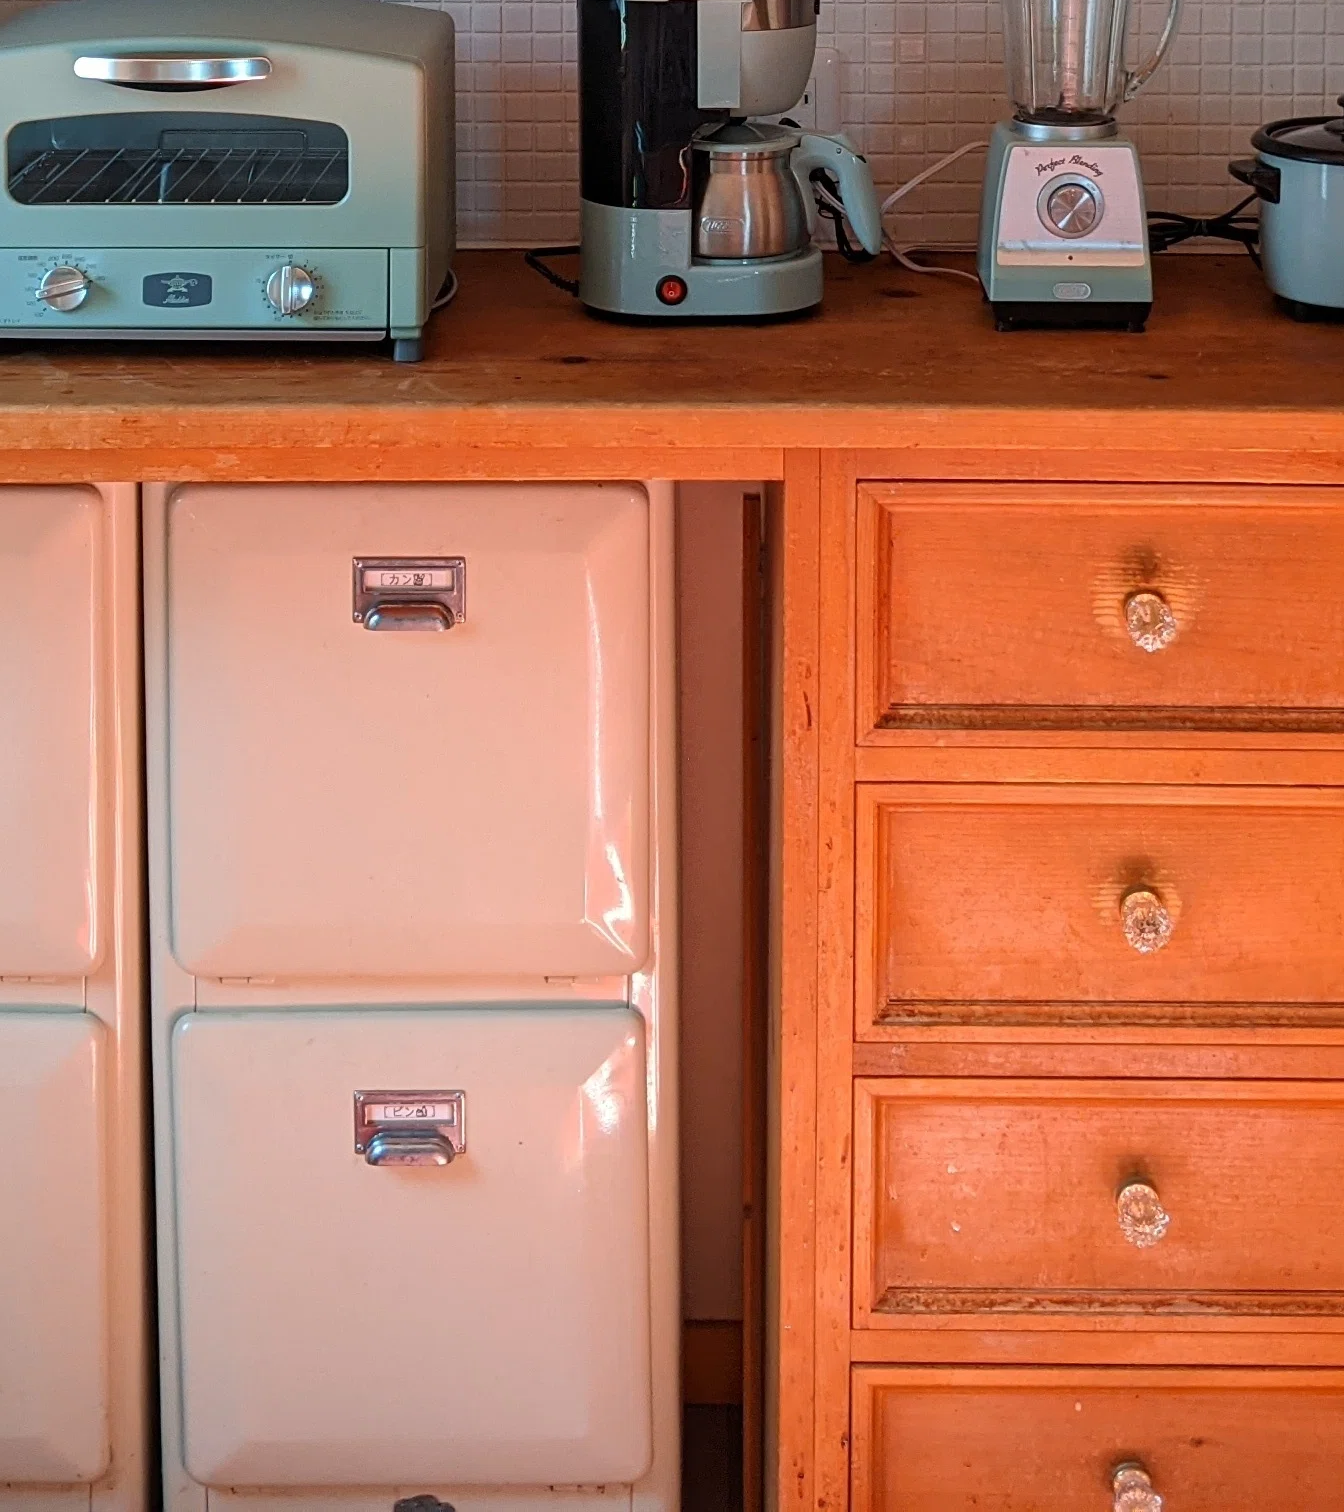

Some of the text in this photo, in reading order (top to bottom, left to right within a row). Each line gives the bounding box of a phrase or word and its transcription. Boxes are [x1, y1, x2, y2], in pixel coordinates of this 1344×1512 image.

[1035, 154, 1104, 178] Perfect Blending
[389, 574, 412, 586] カン
